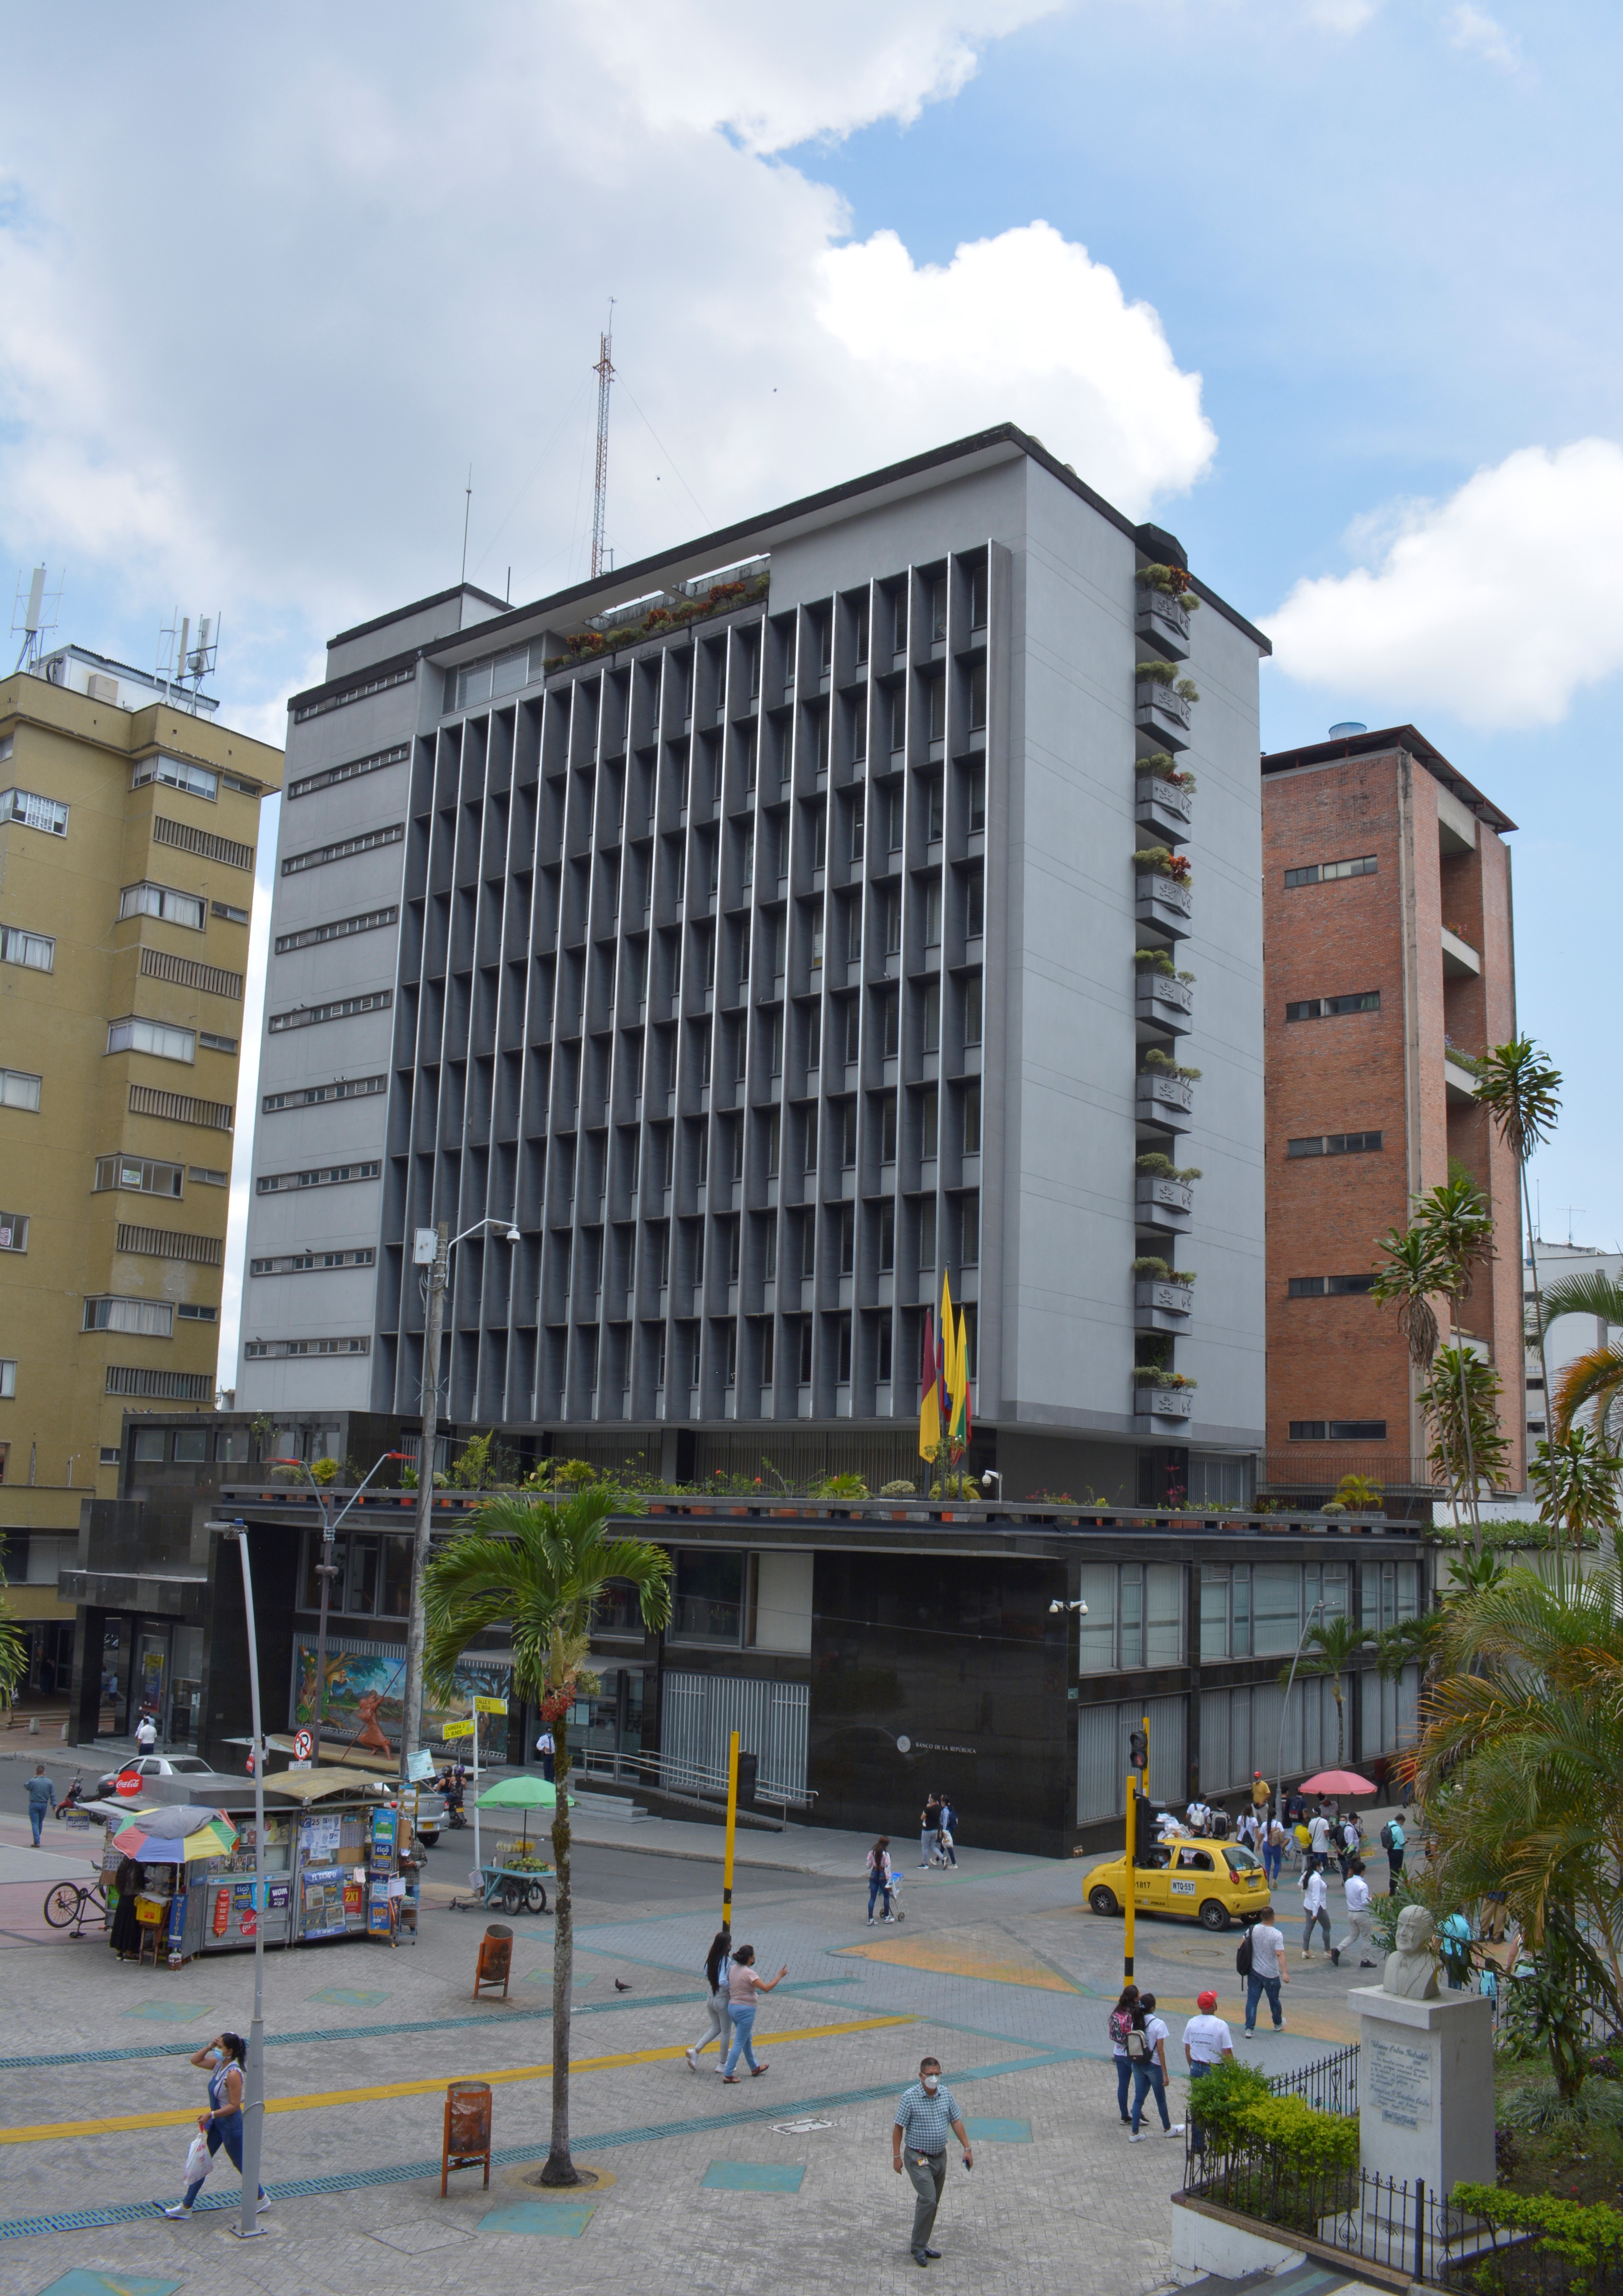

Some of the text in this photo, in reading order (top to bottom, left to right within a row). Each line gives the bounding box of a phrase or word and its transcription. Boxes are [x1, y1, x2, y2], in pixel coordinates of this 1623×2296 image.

[1172, 1882, 1194, 1891] WTQ-557
[272, 1887, 288, 1896] WOM
[346, 1891, 358, 1902] 2X1
